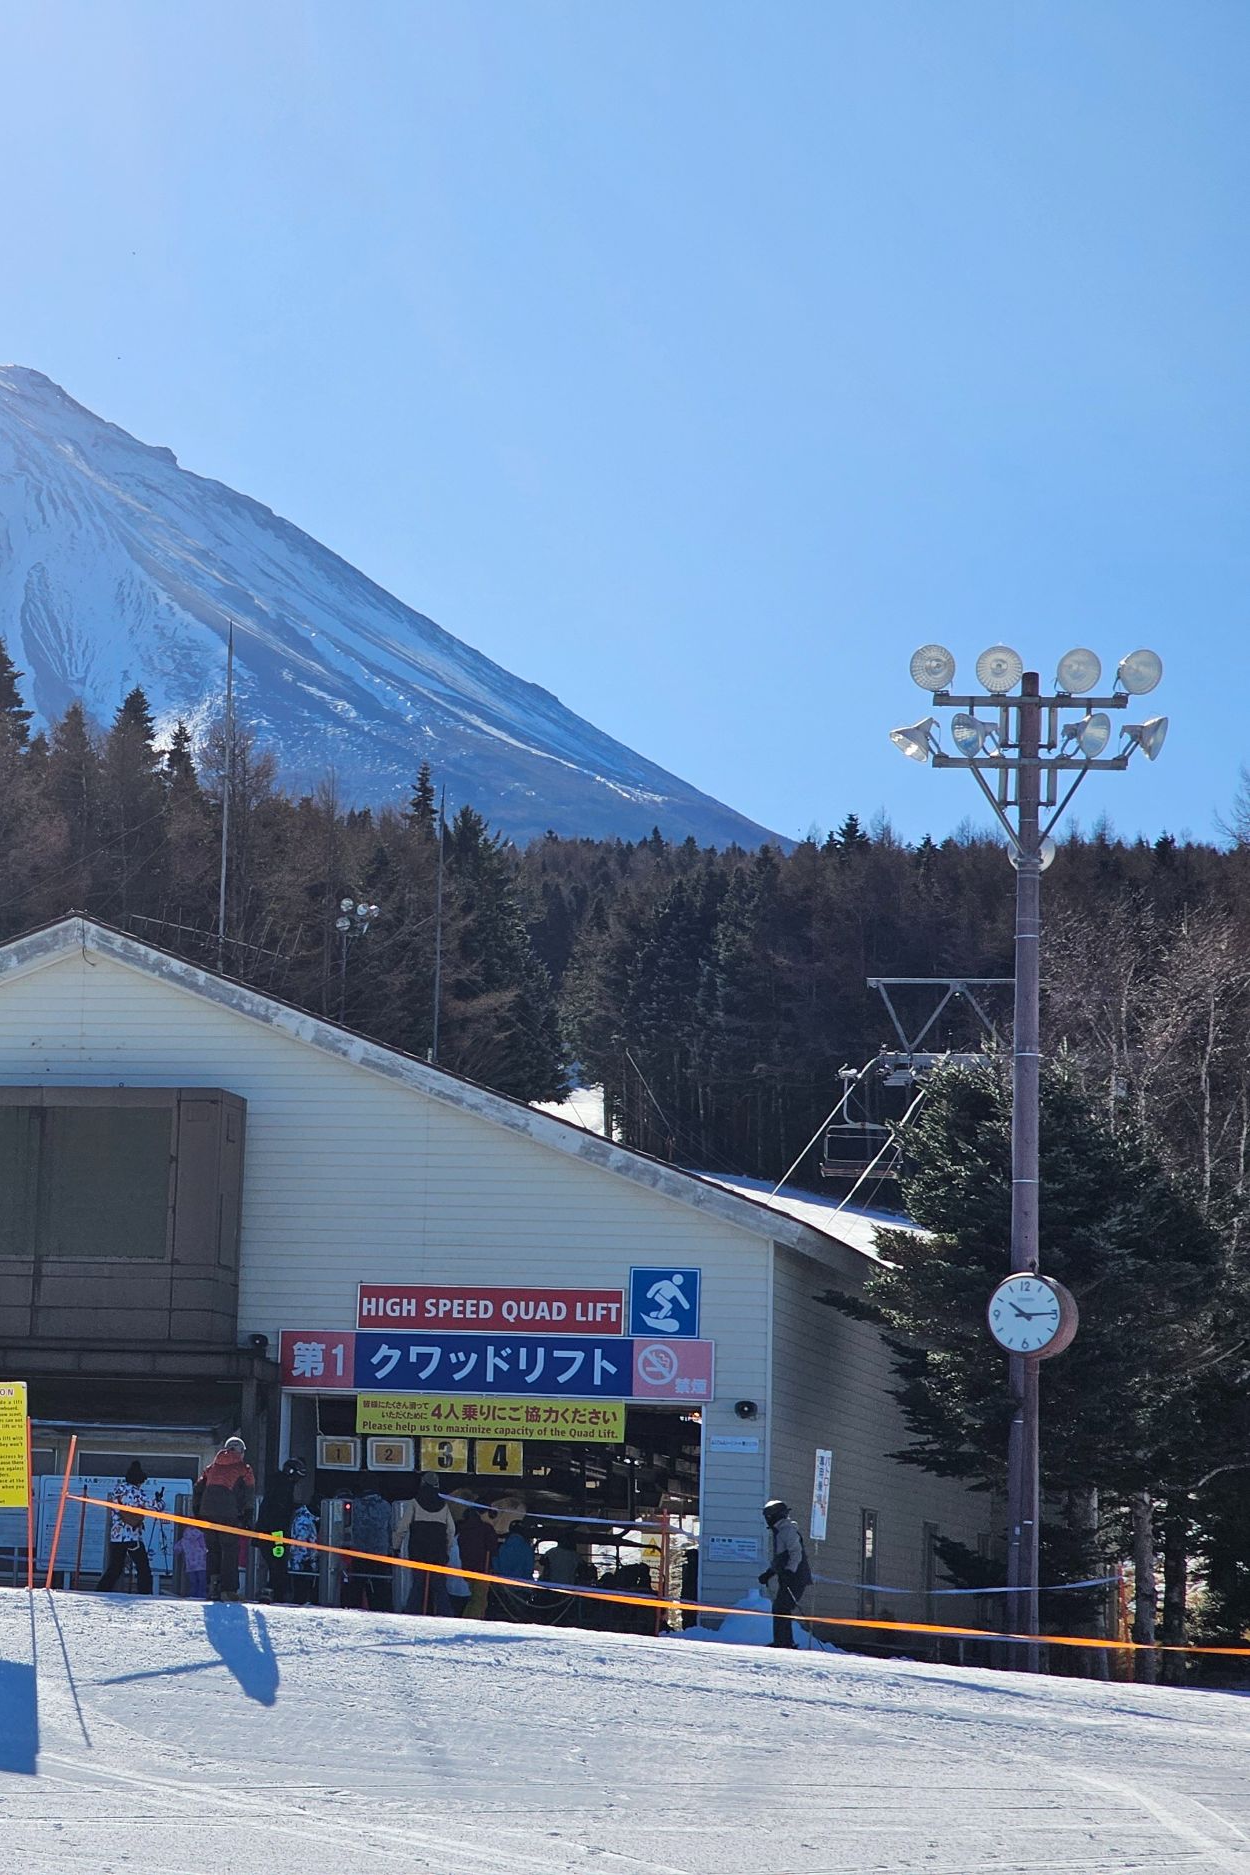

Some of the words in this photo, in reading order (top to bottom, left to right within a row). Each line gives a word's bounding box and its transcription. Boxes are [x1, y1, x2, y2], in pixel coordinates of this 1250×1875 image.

[1021, 1281, 1030, 1291] 12
[362, 1297, 416, 1317] HIGH
[424, 1298, 494, 1319] SPEED
[501, 1301, 567, 1322] QUAD
[575, 1302, 620, 1322] LIFT
[993, 1309, 1000, 1320] 9
[1021, 1338, 1029, 1349] 6
[291, 1341, 344, 1378] 第1
[370, 1343, 618, 1386] クワッドリフト
[675, 1378, 707, 1395] 禁煙
[381, 1411, 428, 1420] いただくために
[431, 1403, 617, 1425] 4人乗りにご協力ください
[363, 1421, 393, 1431] Please
[396, 1422, 416, 1433] help
[434, 1424, 443, 1432] to
[446, 1424, 491, 1434] maximize
[495, 1426, 534, 1437] capacity
[537, 1427, 547, 1436] of
[550, 1427, 566, 1437] the
[569, 1429, 595, 1438] Quad
[598, 1429, 618, 1439] Lift.
[335, 1448, 340, 1460] 1
[385, 1449, 393, 1461] 2
[438, 1442, 453, 1468] 3
[492, 1444, 508, 1470] 4
